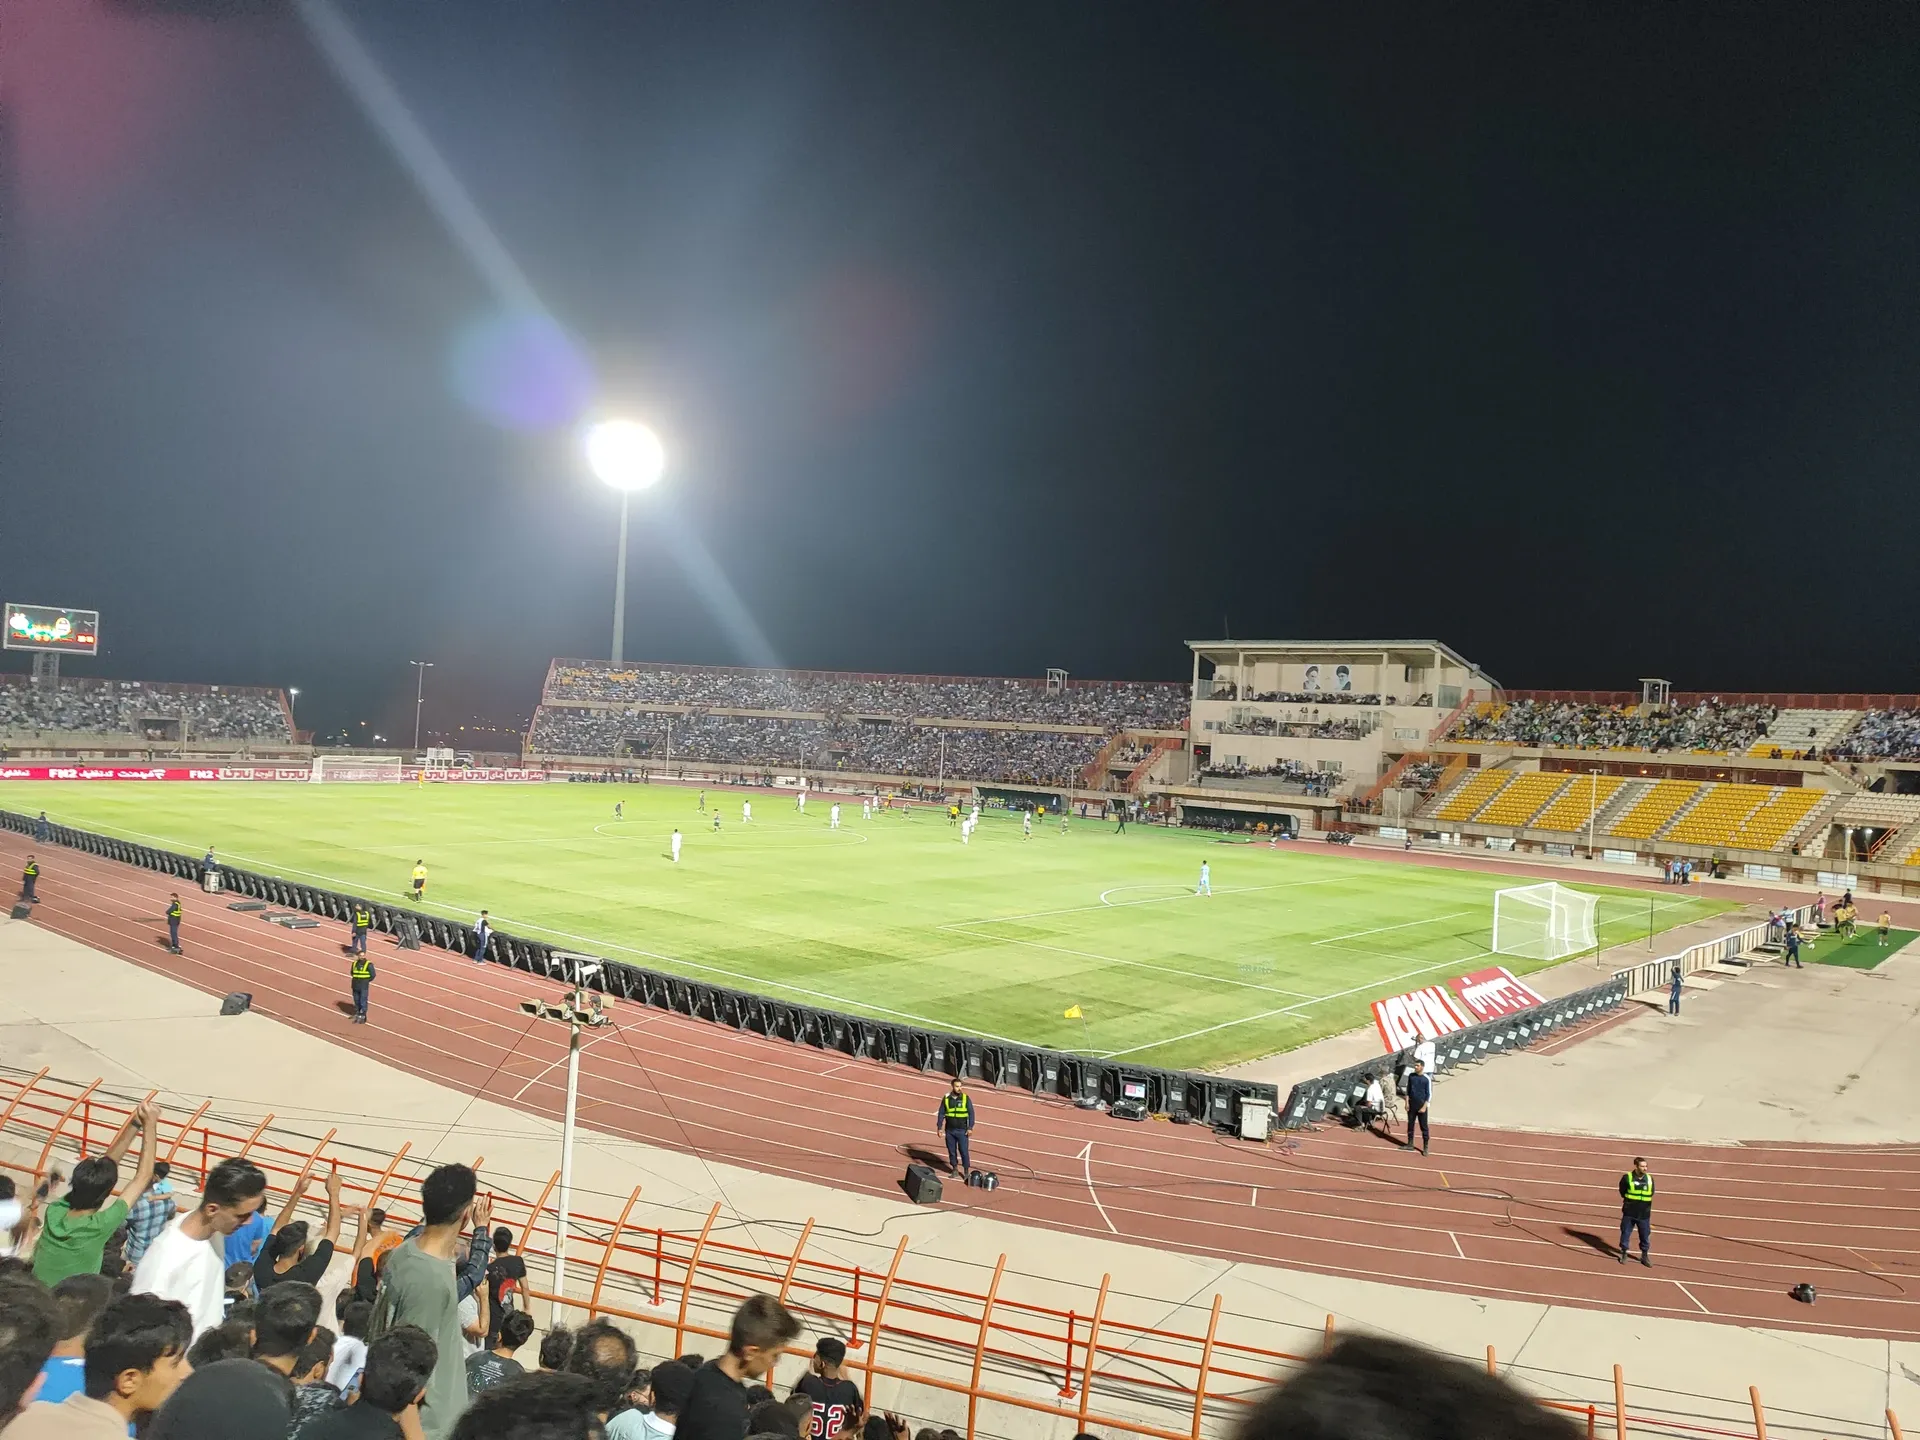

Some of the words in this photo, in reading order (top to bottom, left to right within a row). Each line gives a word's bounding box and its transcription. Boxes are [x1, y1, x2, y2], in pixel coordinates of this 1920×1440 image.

[48, 768, 78, 779] FN2
[189, 769, 214, 779] FN2
[810, 1401, 848, 1439] 52
